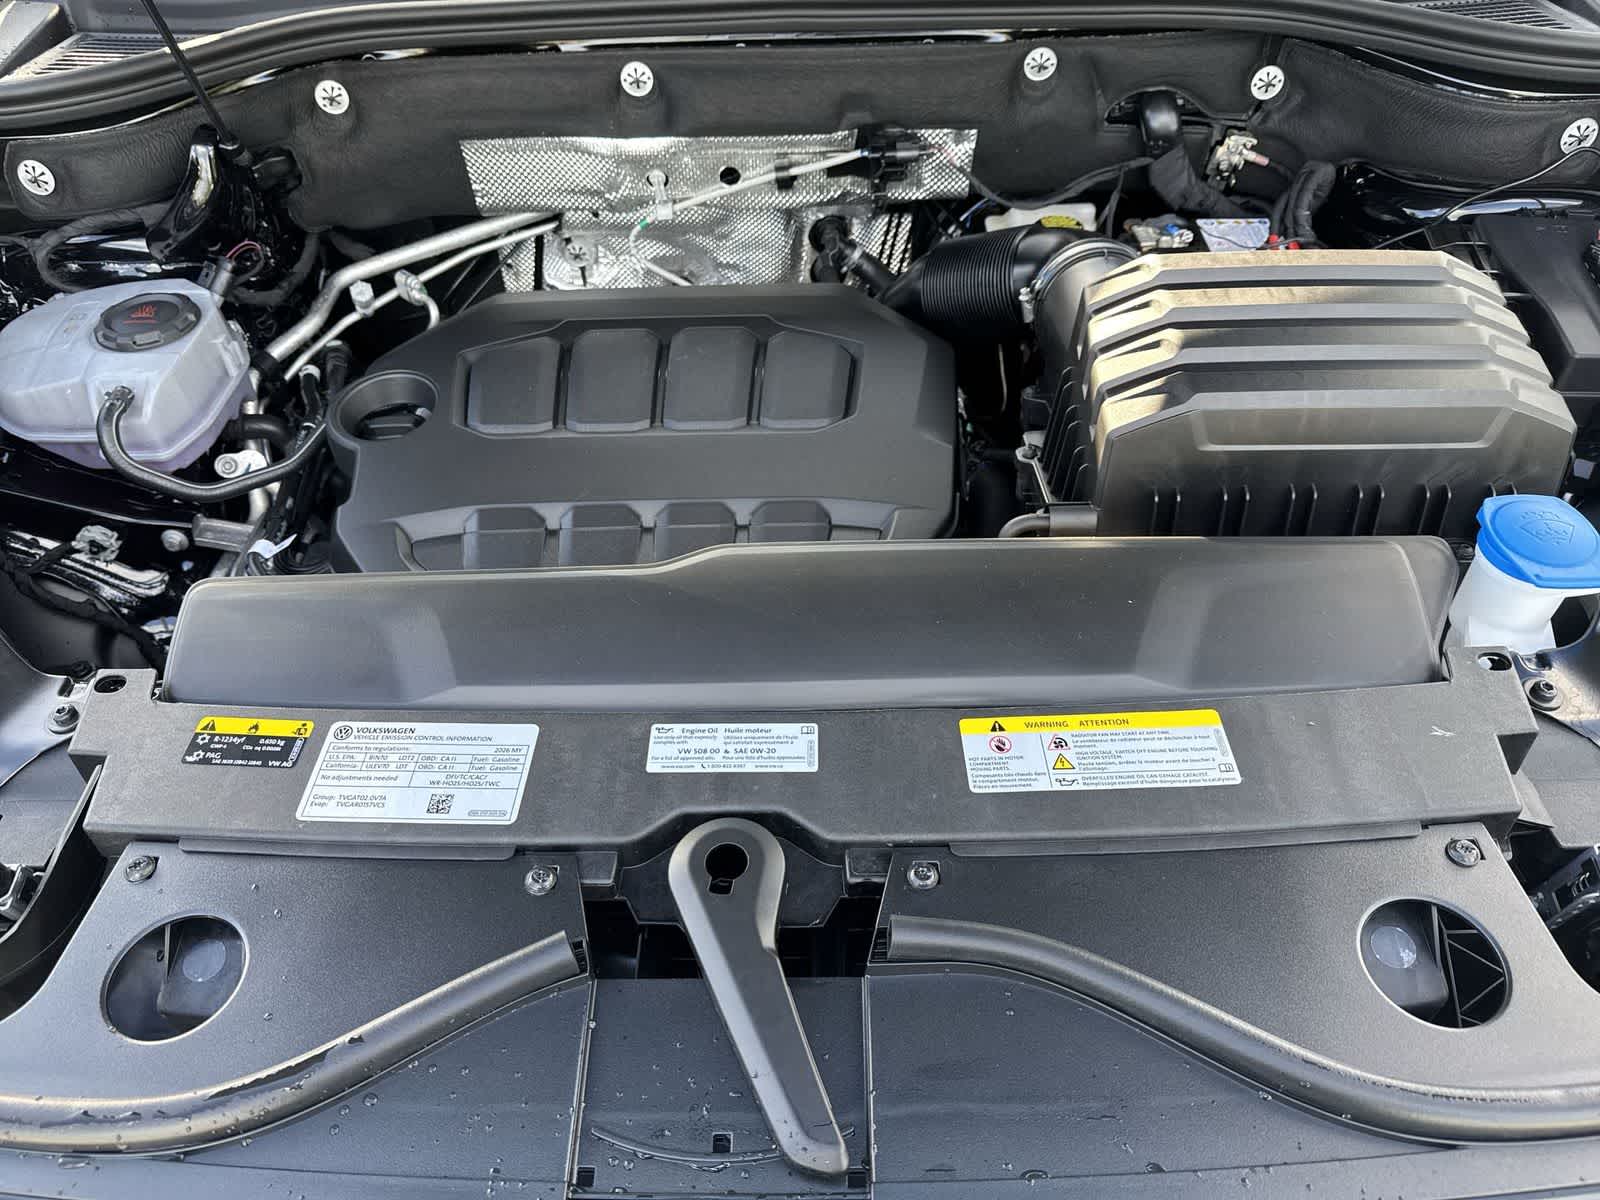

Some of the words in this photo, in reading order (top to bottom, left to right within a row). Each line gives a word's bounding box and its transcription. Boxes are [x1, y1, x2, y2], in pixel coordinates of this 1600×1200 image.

[1024, 720, 1069, 728] WARNING
[1079, 718, 1130, 727] ATTENTION
[213, 736, 246, 745] R-1234yf
